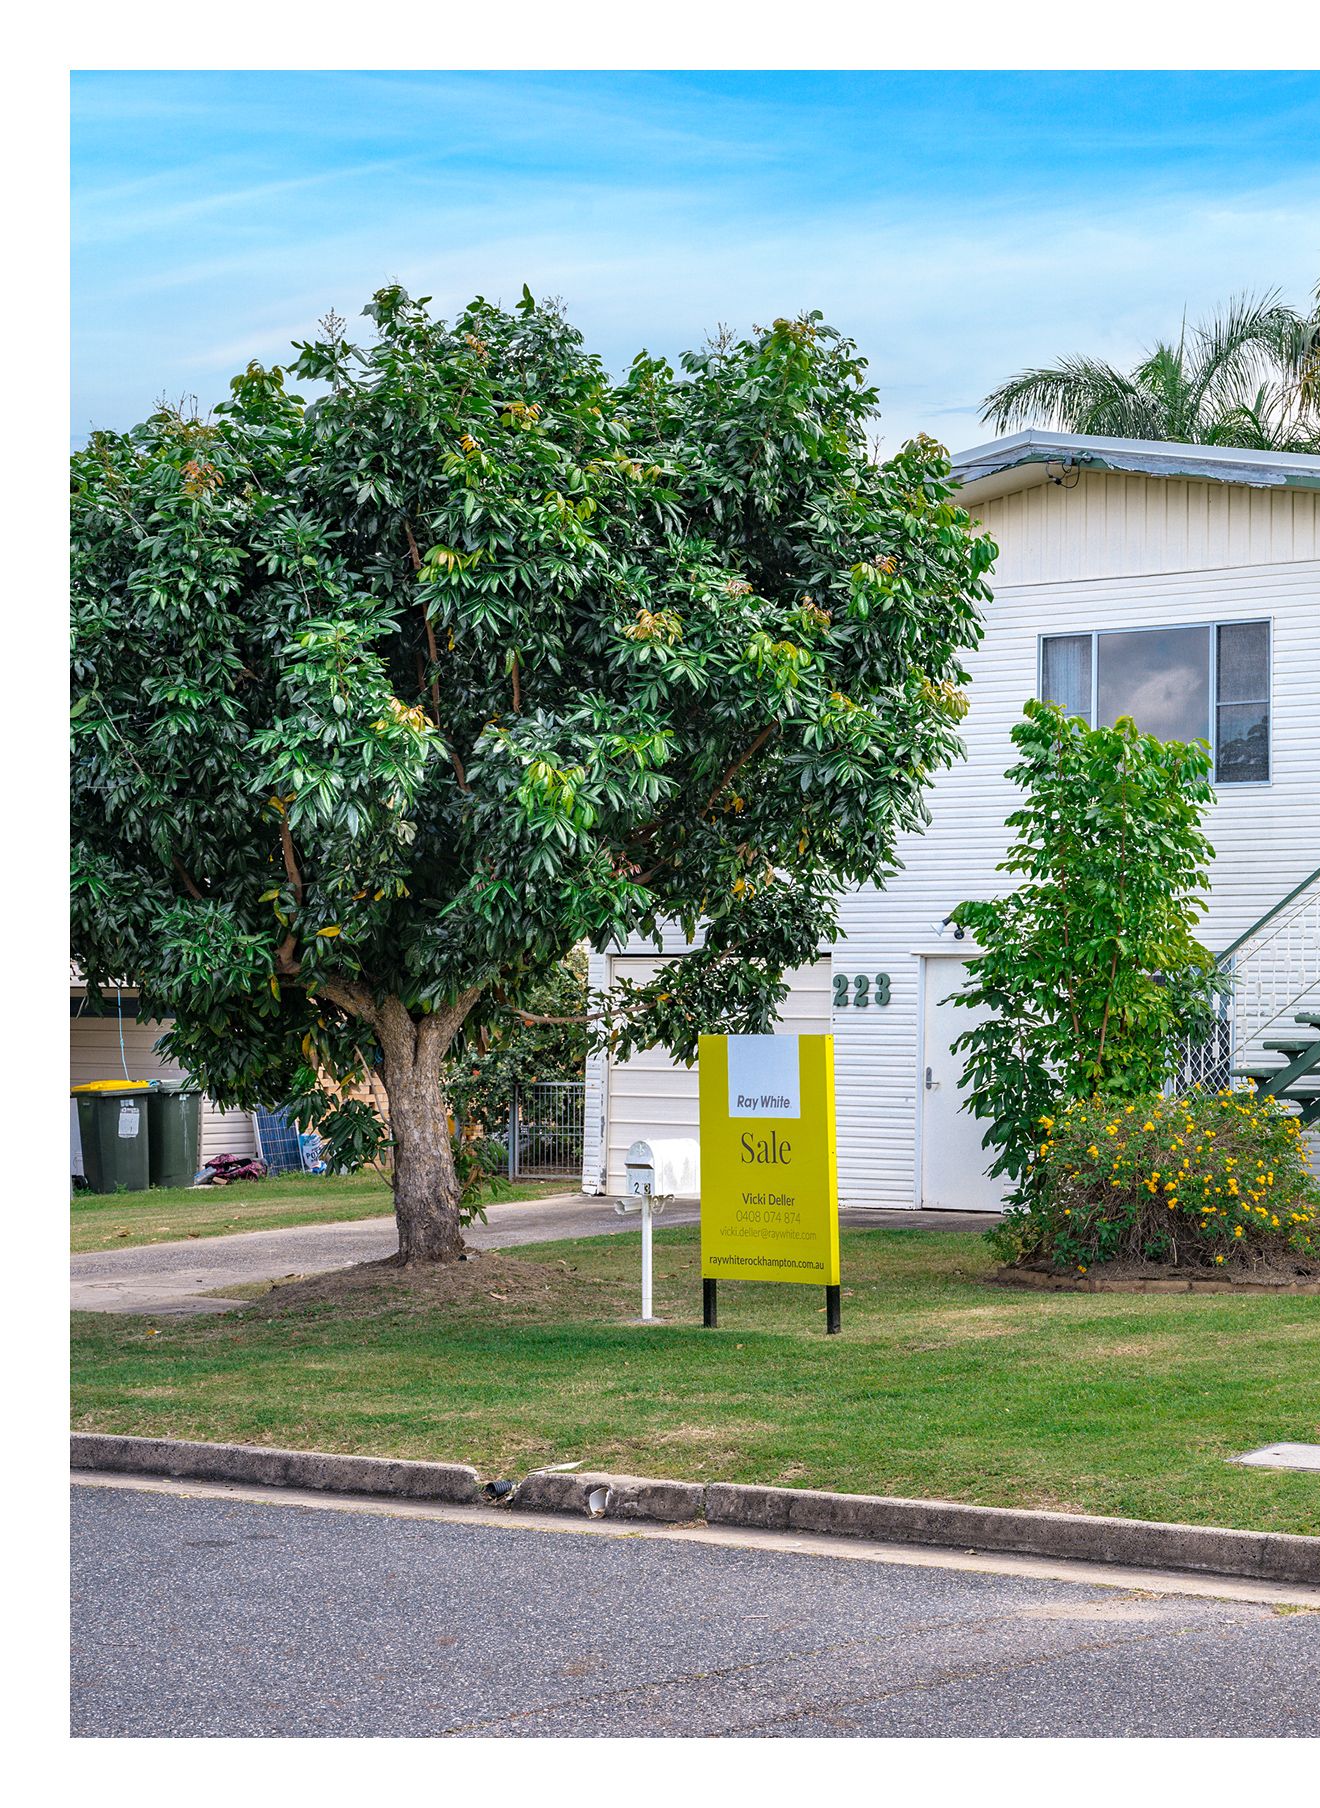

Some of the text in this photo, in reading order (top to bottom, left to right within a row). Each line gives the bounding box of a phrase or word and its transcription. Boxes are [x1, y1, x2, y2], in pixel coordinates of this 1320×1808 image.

[833, 973, 891, 1007] 223
[737, 1095, 790, 1110] Ray White
[741, 1130, 792, 1165] Sale
[742, 1193, 795, 1207] Vicki Deller
[736, 1209, 801, 1225] 0408 074 874
[709, 1254, 825, 1270] raywhiterockhampton.com.au
